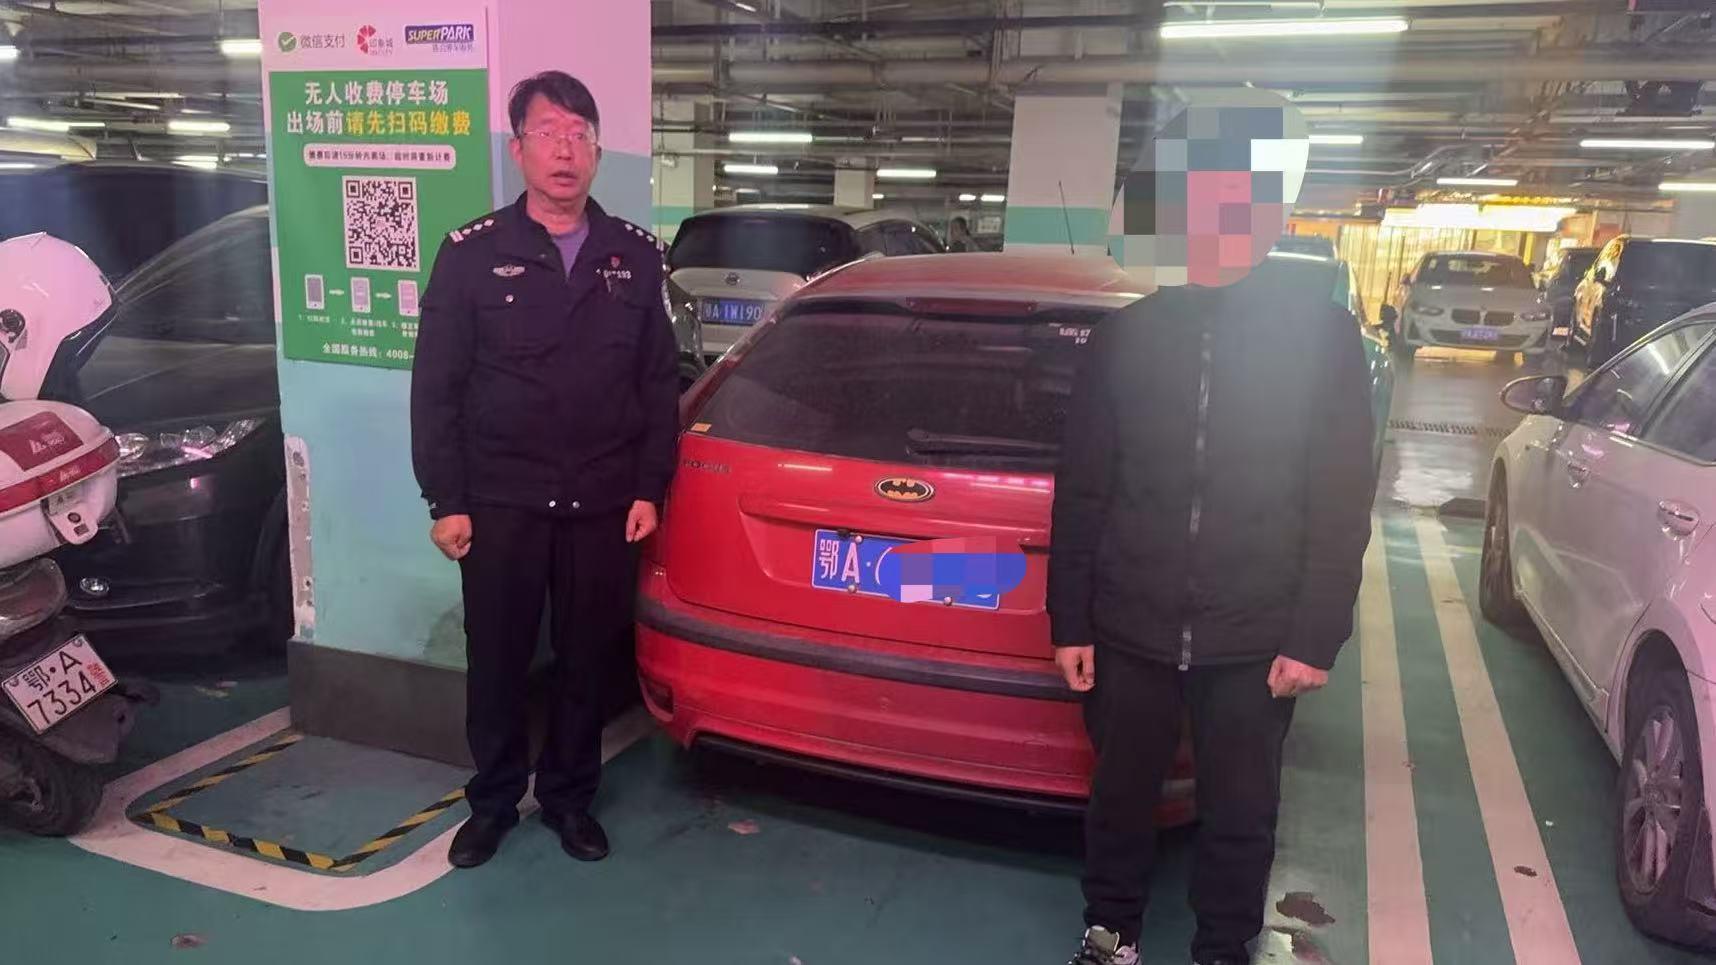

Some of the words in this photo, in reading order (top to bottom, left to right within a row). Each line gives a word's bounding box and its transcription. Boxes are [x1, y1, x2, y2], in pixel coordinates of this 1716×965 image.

[300, 34, 346, 49] 微信支付
[407, 25, 472, 42] SUPERPARK
[304, 80, 449, 105] 无人收费停车场
[287, 110, 471, 136] 出场前请先扫码缴费
[27, 670, 97, 724] 7334
